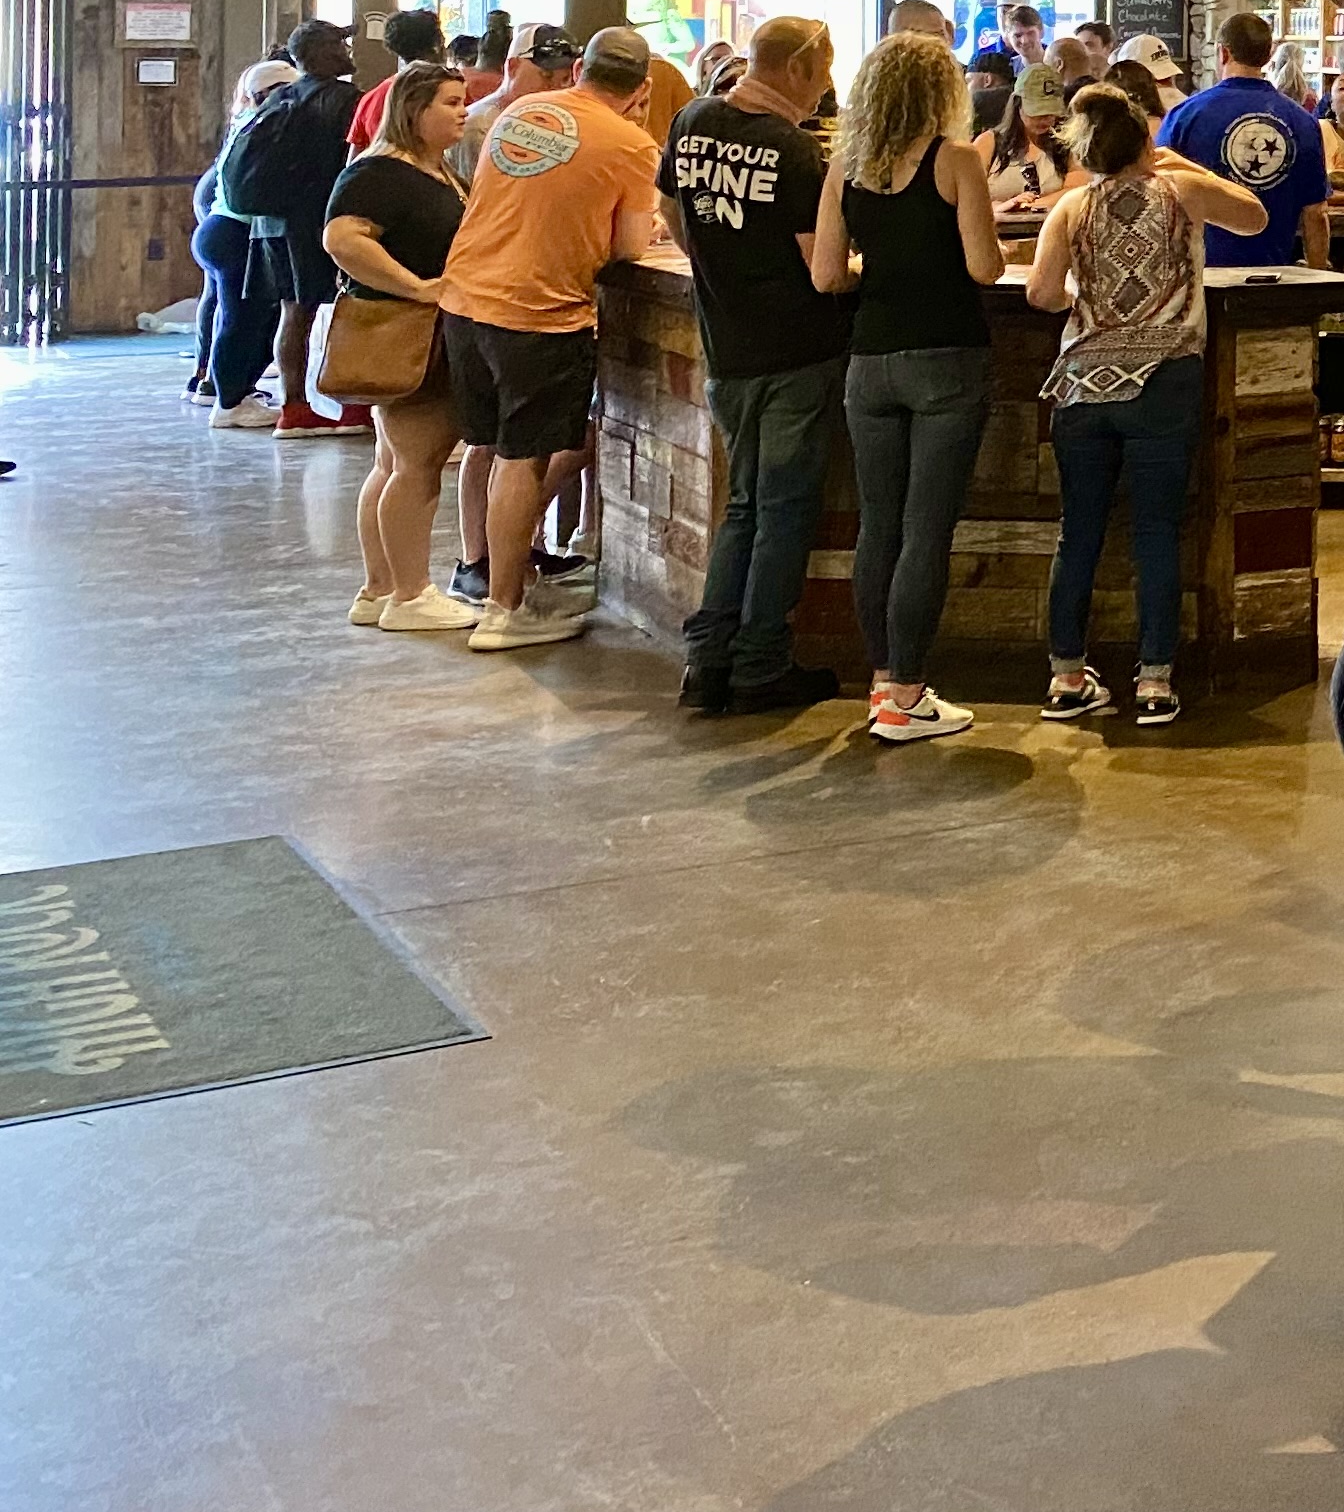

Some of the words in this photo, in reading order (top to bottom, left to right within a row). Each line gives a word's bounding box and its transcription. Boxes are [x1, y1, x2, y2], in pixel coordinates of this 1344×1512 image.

[676, 135, 714, 155] GET
[715, 140, 779, 168] YOUR
[675, 157, 778, 203] SHINE
